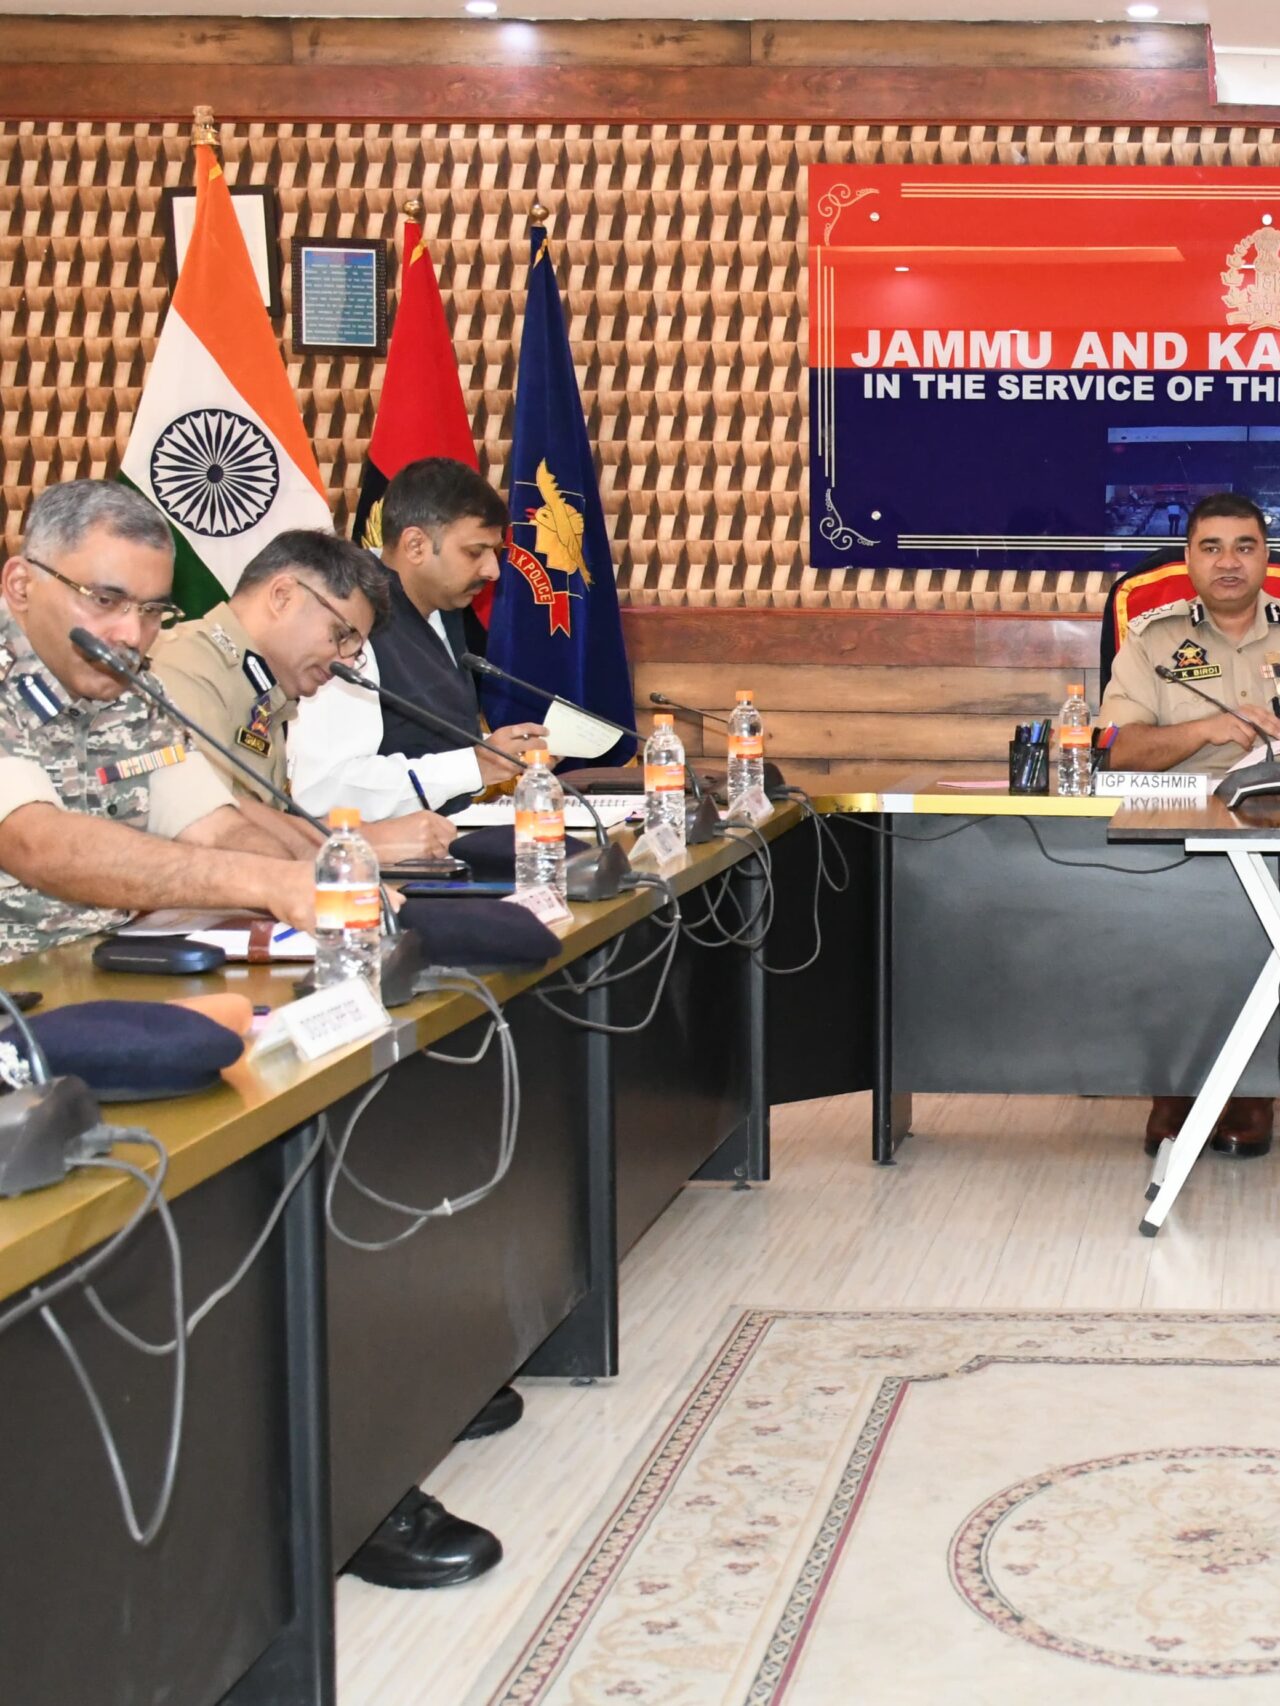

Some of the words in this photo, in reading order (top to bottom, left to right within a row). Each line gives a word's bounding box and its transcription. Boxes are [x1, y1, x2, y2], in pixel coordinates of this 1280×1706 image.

[851, 329, 1052, 369] JAMMU
[1071, 331, 1188, 370] AND
[863, 373, 900, 399] IN
[912, 374, 986, 400] THE
[997, 374, 1155, 401] SERVICE
[1166, 376, 1215, 402] OF
[523, 562, 551, 602] POLICE
[1193, 666, 1218, 677] BIRDI
[1101, 775, 1126, 788] IGP
[1130, 775, 1197, 788] KASHMIR
